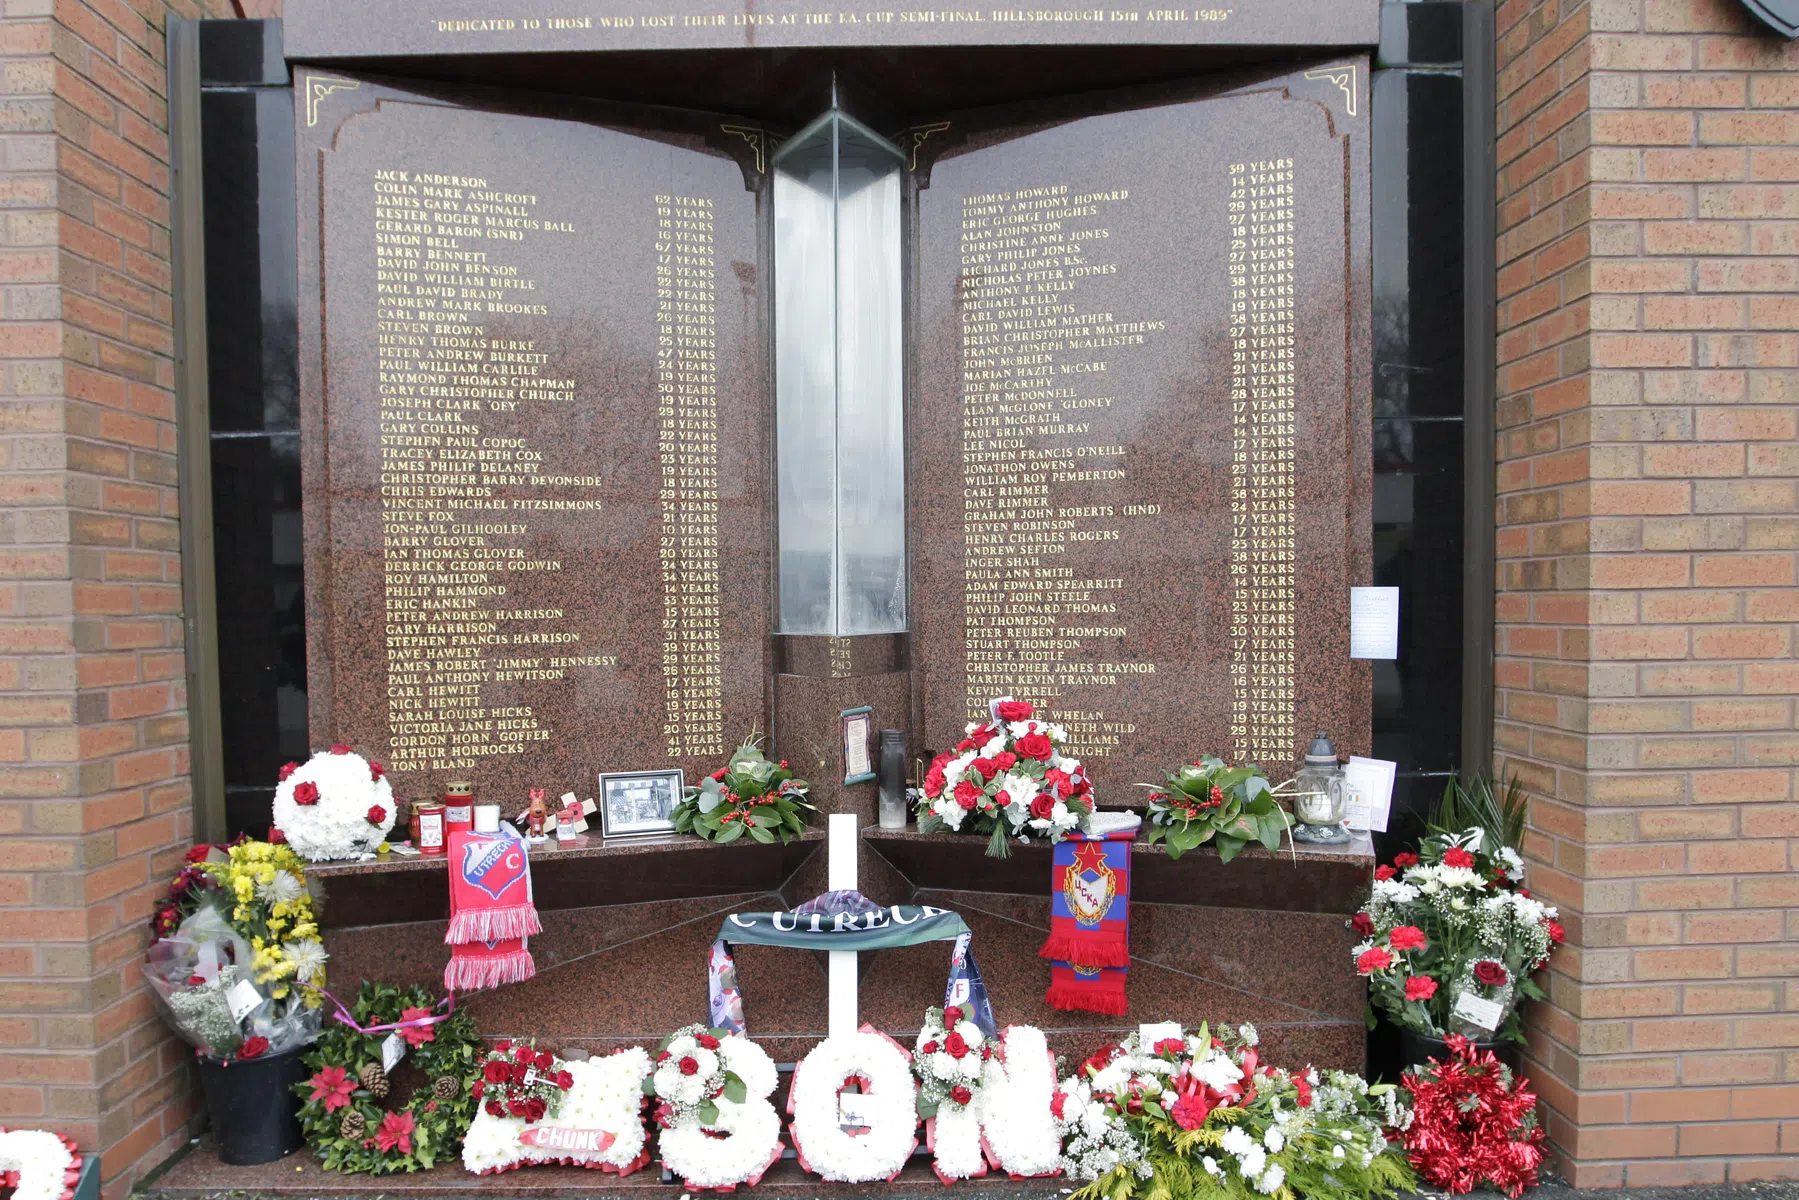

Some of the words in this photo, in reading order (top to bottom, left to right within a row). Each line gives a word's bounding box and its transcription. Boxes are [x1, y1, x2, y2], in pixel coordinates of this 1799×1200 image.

[521, 18, 541, 30] TO
[546, 16, 592, 29] THOSE
[600, 16, 635, 28] WHO
[641, 15, 676, 28] LOST
[684, 14, 726, 26] THEIR
[733, 13, 774, 25] LIVES
[780, 13, 797, 25] AT
[804, 12, 831, 24] THE
[866, 11, 894, 23] CUP
[992, 10, 1104, 22] HILLSBOROUGH
[1146, 9, 1189, 21] APRIL
[374, 170, 408, 181] JACK
[414, 173, 486, 187] ANDERSON
[373, 182, 416, 194] COLIN
[423, 186, 462, 198] MARK
[468, 190, 536, 203] ASHCROFT
[1230, 188, 1245, 198] 42
[1250, 183, 1293, 197] YEARS
[963, 204, 1004, 217] TOMMY
[1010, 196, 1068, 211] ANTHONY
[1074, 189, 1128, 204] HOWARD
[376, 208, 427, 220] KESTER
[434, 212, 478, 224] ROGER
[485, 216, 539, 228] MARCUS
[544, 220, 575, 230] BALL
[657, 206, 670, 216] 19
[675, 208, 713, 219] YEARS
[962, 273, 1021, 287] NICHOLAS
[1026, 269, 1063, 281] PETER
[1068, 263, 1116, 277] JOYNES
[1230, 276, 1245, 286] 38
[1251, 272, 1293, 285] YEARS
[657, 276, 671, 286] 22
[676, 278, 714, 289] YEARS
[377, 283, 410, 294] PAUL
[416, 285, 455, 297] DAVID
[461, 287, 503, 299] BRADY
[377, 296, 436, 307] ANDREW
[442, 299, 481, 311] MARK
[487, 302, 547, 314] BROOKES
[963, 297, 1016, 310] MICHAEL
[1021, 293, 1058, 305] KELLY
[377, 321, 428, 332] STEVEN
[435, 323, 483, 335] BROWN
[963, 334, 999, 345] BRIAN
[1004, 326, 1089, 341] CHRISTOPHER
[1095, 320, 1165, 334] MATTHEWS
[659, 336, 672, 345] 25
[677, 337, 715, 347] YEARS
[379, 359, 411, 370] PAUL
[417, 361, 477, 372] WILLIAM
[482, 363, 538, 375] CARLILE
[379, 372, 446, 383] RAYMOND
[452, 375, 507, 386] THOMAS
[510, 376, 575, 388] CHAPMAN
[1233, 401, 1246, 411] 17
[1251, 398, 1294, 410] YEARS
[379, 422, 415, 432] GARY
[420, 423, 479, 434] COLLINS
[963, 428, 991, 439] PAUL
[996, 426, 1033, 437] BRIAN
[1038, 422, 1089, 434] MURRAY
[659, 430, 674, 440] 22
[678, 431, 716, 441] YEARS
[380, 447, 432, 458] TRACEY
[439, 449, 510, 460] ELIZABETH
[515, 450, 542, 460] COX
[962, 450, 1015, 462] STEPHEN
[1020, 447, 1072, 459] FRANCIS
[380, 473, 476, 484] CHRISTOPHER
[483, 474, 525, 484] BARRY
[530, 475, 601, 485] DEVONSIDE
[964, 474, 1017, 485] WILLIAM
[1023, 472, 1046, 483] ROY
[1052, 468, 1125, 481] PEMBERTON
[382, 498, 442, 508] VINCENT
[447, 499, 508, 509] MICHAEL
[512, 499, 601, 510] FITZSIMMONS
[964, 510, 1015, 520] GRAHAM
[1020, 508, 1053, 518] JOHN
[1058, 505, 1113, 517] ROBERTS
[1122, 503, 1160, 514] (HND)
[1233, 514, 1246, 524] 17
[1251, 512, 1295, 523] YEARS
[965, 534, 1003, 544] HENRY
[1009, 531, 1064, 542] CHARLES
[1069, 529, 1119, 540] ROGERS
[383, 548, 407, 558] IAN
[413, 548, 469, 558] THOMAS
[473, 548, 524, 558] GLOVER
[659, 548, 675, 557] 20
[680, 548, 717, 557] YEARS
[384, 574, 411, 583] ROY
[418, 573, 487, 583] HAMILTON
[965, 581, 997, 590] ADAM
[1003, 580, 1052, 590] EDWARD
[1056, 578, 1123, 589] SPEARRITT
[1235, 589, 1247, 599] 15
[1252, 588, 1294, 598] YEARS
[385, 611, 427, 621] PETER
[432, 610, 489, 620] ANDREW
[495, 609, 563, 619] HARRISON
[665, 631, 676, 640] 31
[681, 630, 719, 639] YEARS
[966, 628, 1001, 637] PETER
[1007, 627, 1053, 637] REUBEN
[1058, 626, 1127, 636] THOMPSON
[386, 635, 445, 646] STEPHEN
[451, 634, 508, 645] FRANCIS
[512, 633, 579, 644] HARRISON
[965, 662, 1049, 672] CHRISTOPHER
[1054, 662, 1093, 672] JAMES
[1097, 662, 1155, 671] TRAYNOR
[387, 673, 420, 684] PAUL
[425, 672, 490, 683] ANTHONY
[495, 670, 563, 681] HEWITSON
[966, 686, 1002, 695] KEVIN
[1007, 686, 1061, 695] TYRRELL
[1234, 689, 1247, 698] 15
[1251, 688, 1294, 698] YEARS
[967, 709, 988, 718] IAN
[1052, 710, 1104, 721] WHELAN
[389, 722, 454, 733] VICTORIA
[458, 720, 492, 731] JANE
[497, 719, 537, 729] HICKS
[663, 724, 679, 733] 20
[683, 722, 722, 732] YEARS
[1103, 722, 1136, 734] WILD
[1067, 735, 1120, 745] ILLIAMS
[1234, 738, 1247, 747] 15
[1251, 738, 1293, 748] YEARS
[390, 747, 445, 758] ARTHUR
[451, 744, 523, 756] HORROCKS
[1061, 746, 1111, 757] WRIGHT
[473, 840, 515, 877] UTRECH
[1074, 878, 1099, 908] ЦСКА
[535, 1127, 600, 1151] CHUNK
